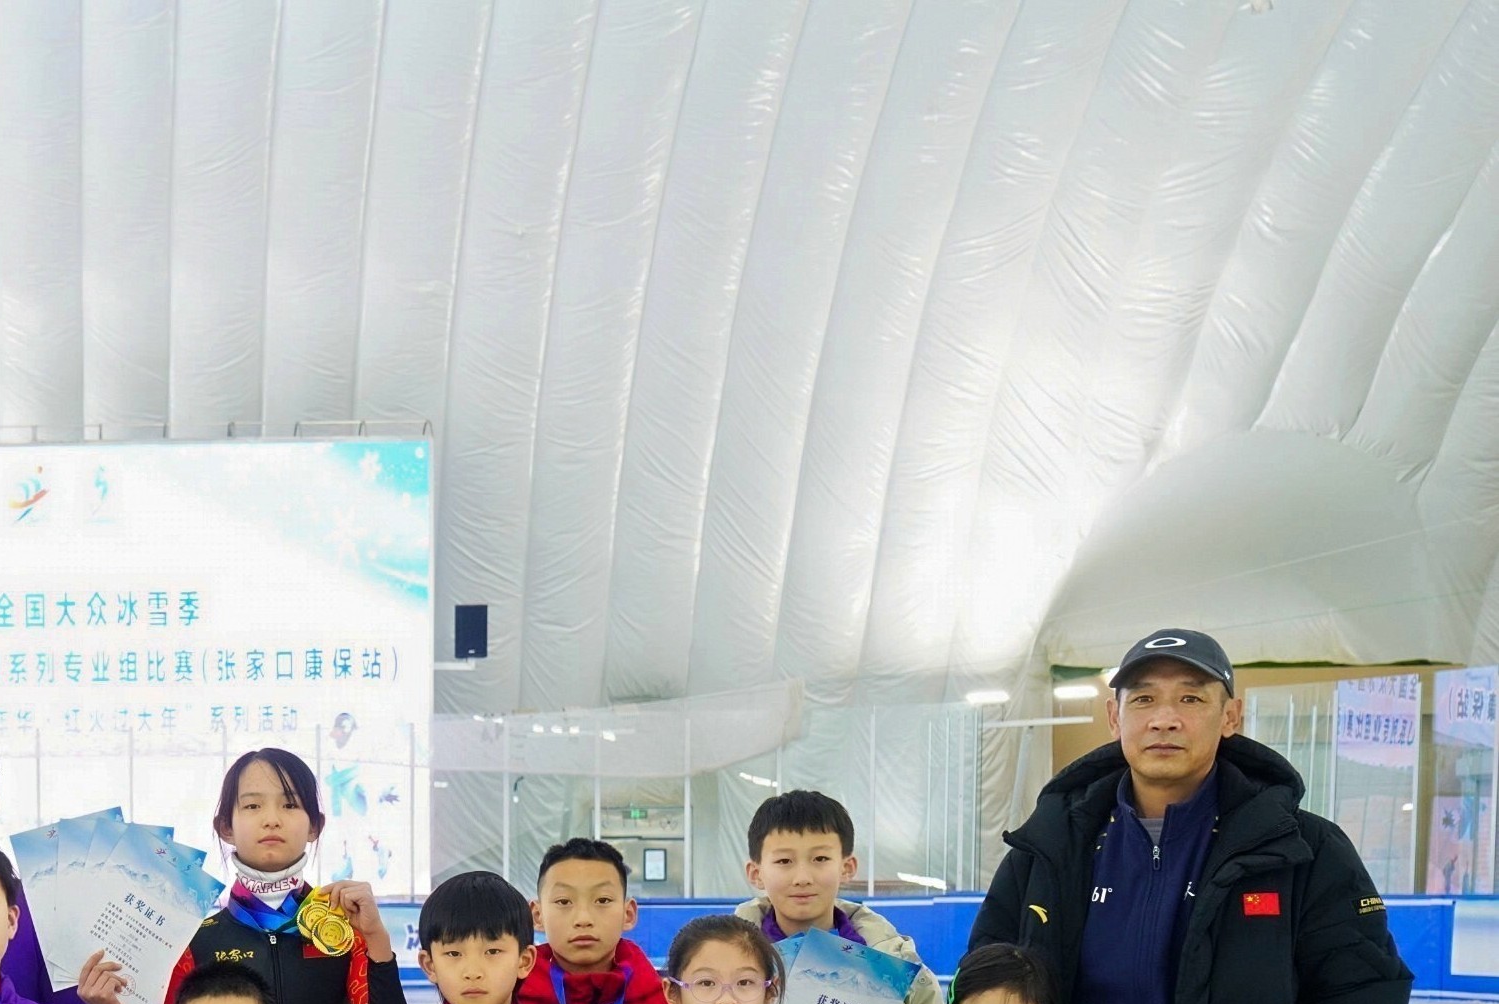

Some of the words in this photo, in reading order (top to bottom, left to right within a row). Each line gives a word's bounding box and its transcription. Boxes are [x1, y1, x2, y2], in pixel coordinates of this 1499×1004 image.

[240, 876, 291, 894] MAPLE
[124, 892, 166, 927] 获奖证书
